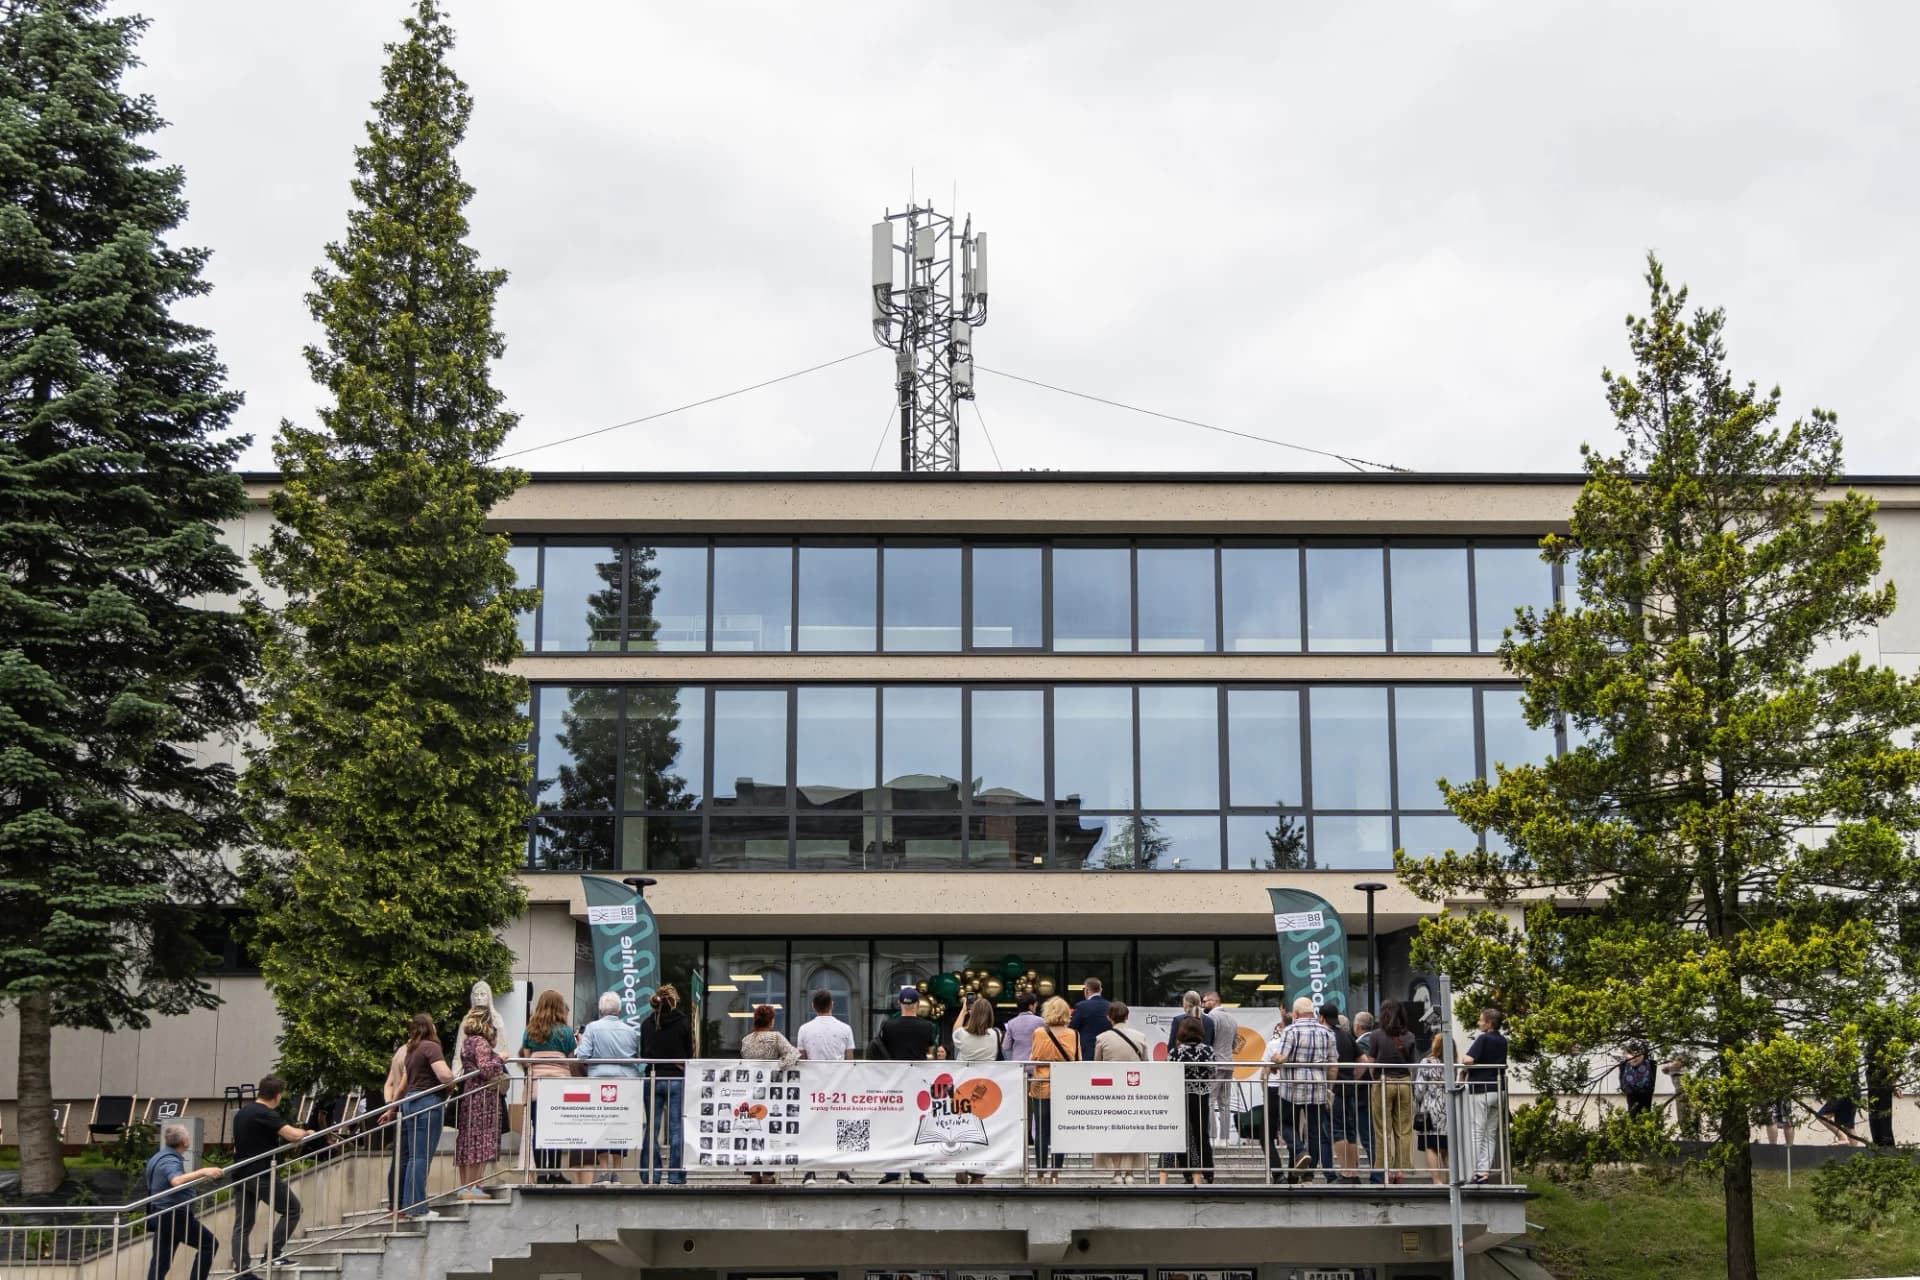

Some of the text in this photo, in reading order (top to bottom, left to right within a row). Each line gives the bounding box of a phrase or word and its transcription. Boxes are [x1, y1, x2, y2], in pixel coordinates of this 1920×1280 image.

[810, 1092, 904, 1104] 18-21 czerwca
[930, 1083, 954, 1099] UN
[932, 1098, 972, 1118] PLUG
